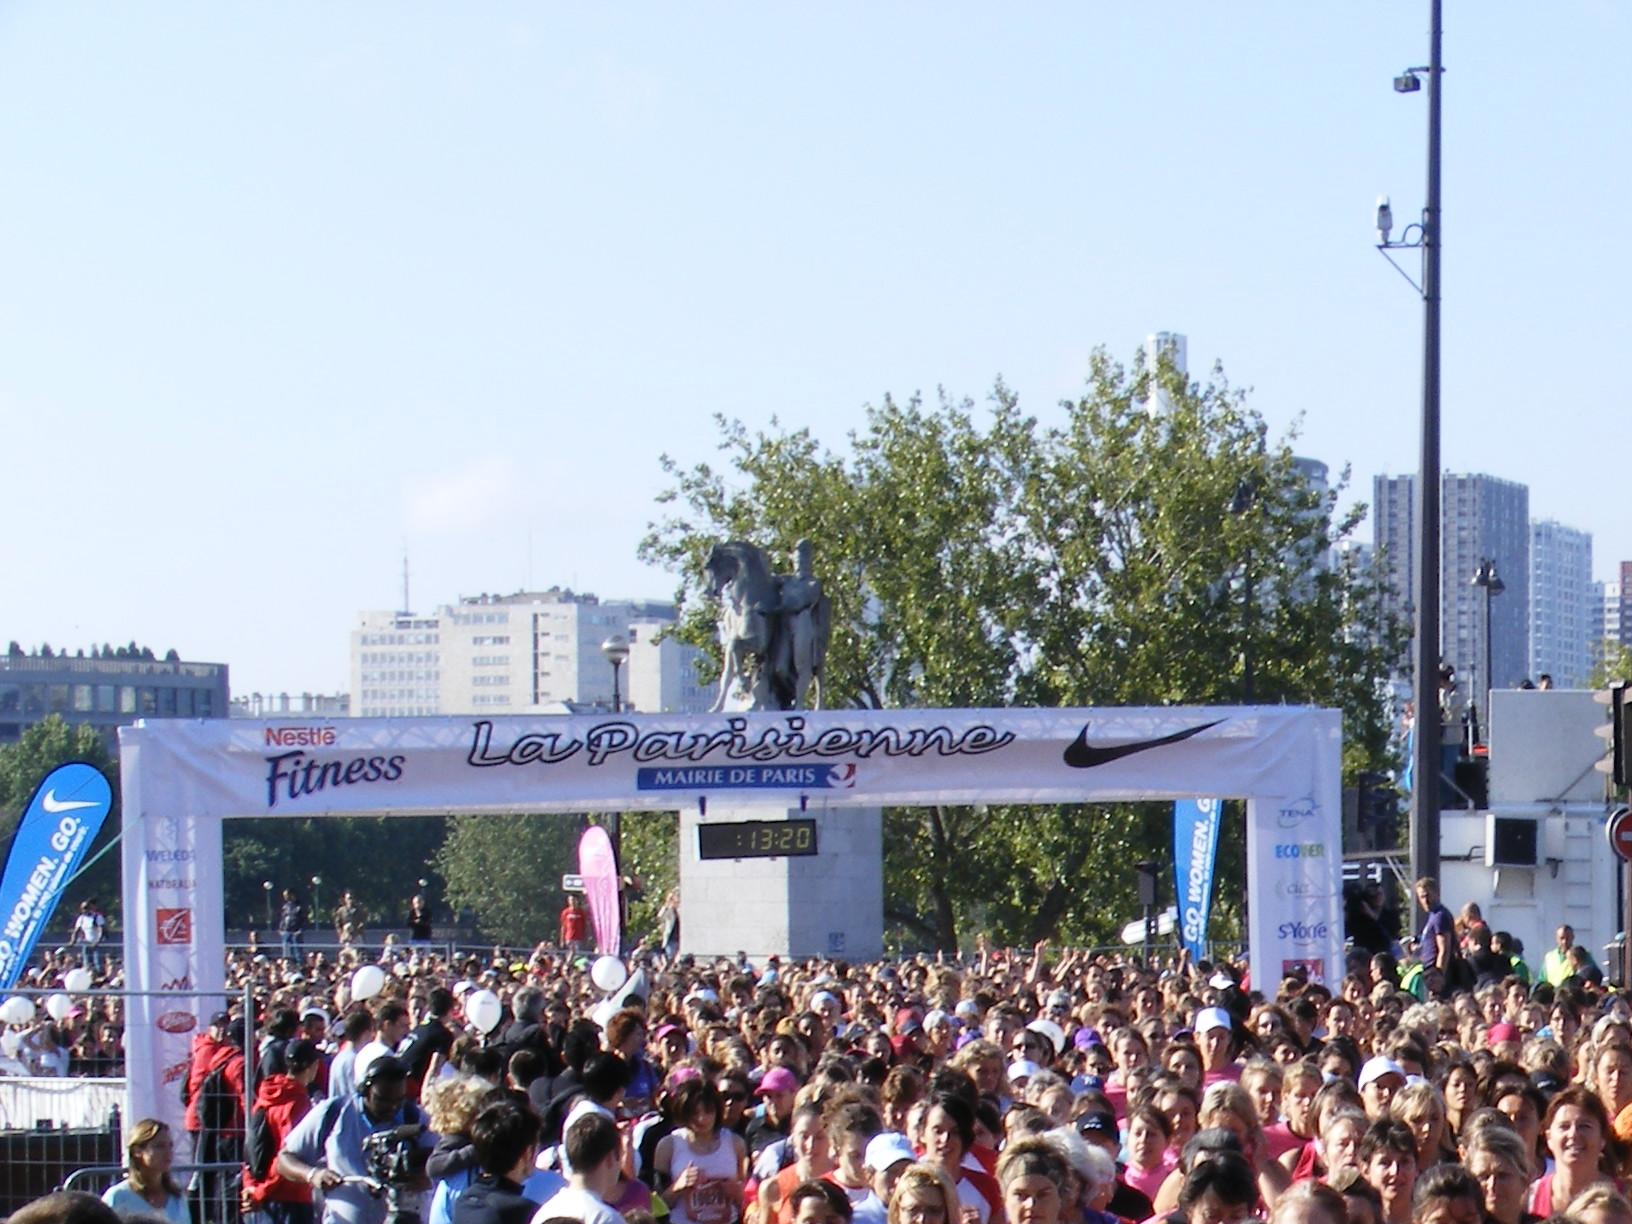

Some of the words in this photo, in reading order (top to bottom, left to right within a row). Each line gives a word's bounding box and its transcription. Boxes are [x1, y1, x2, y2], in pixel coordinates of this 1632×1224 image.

[468, 719, 586, 768] La
[586, 716, 1017, 766] Parisienne
[264, 750, 406, 808] Fitness
[654, 768, 725, 787] MAIRIE
[728, 768, 757, 785] DE
[760, 766, 816, 784] PARIS
[1279, 809, 1316, 818] TENA
[1188, 820, 1210, 904] WOMEN.
[1275, 843, 1325, 859] ECOVER
[4, 856, 60, 940] WOMEN.
[51, 816, 82, 852] GO.
[1183, 907, 1201, 943] GO
